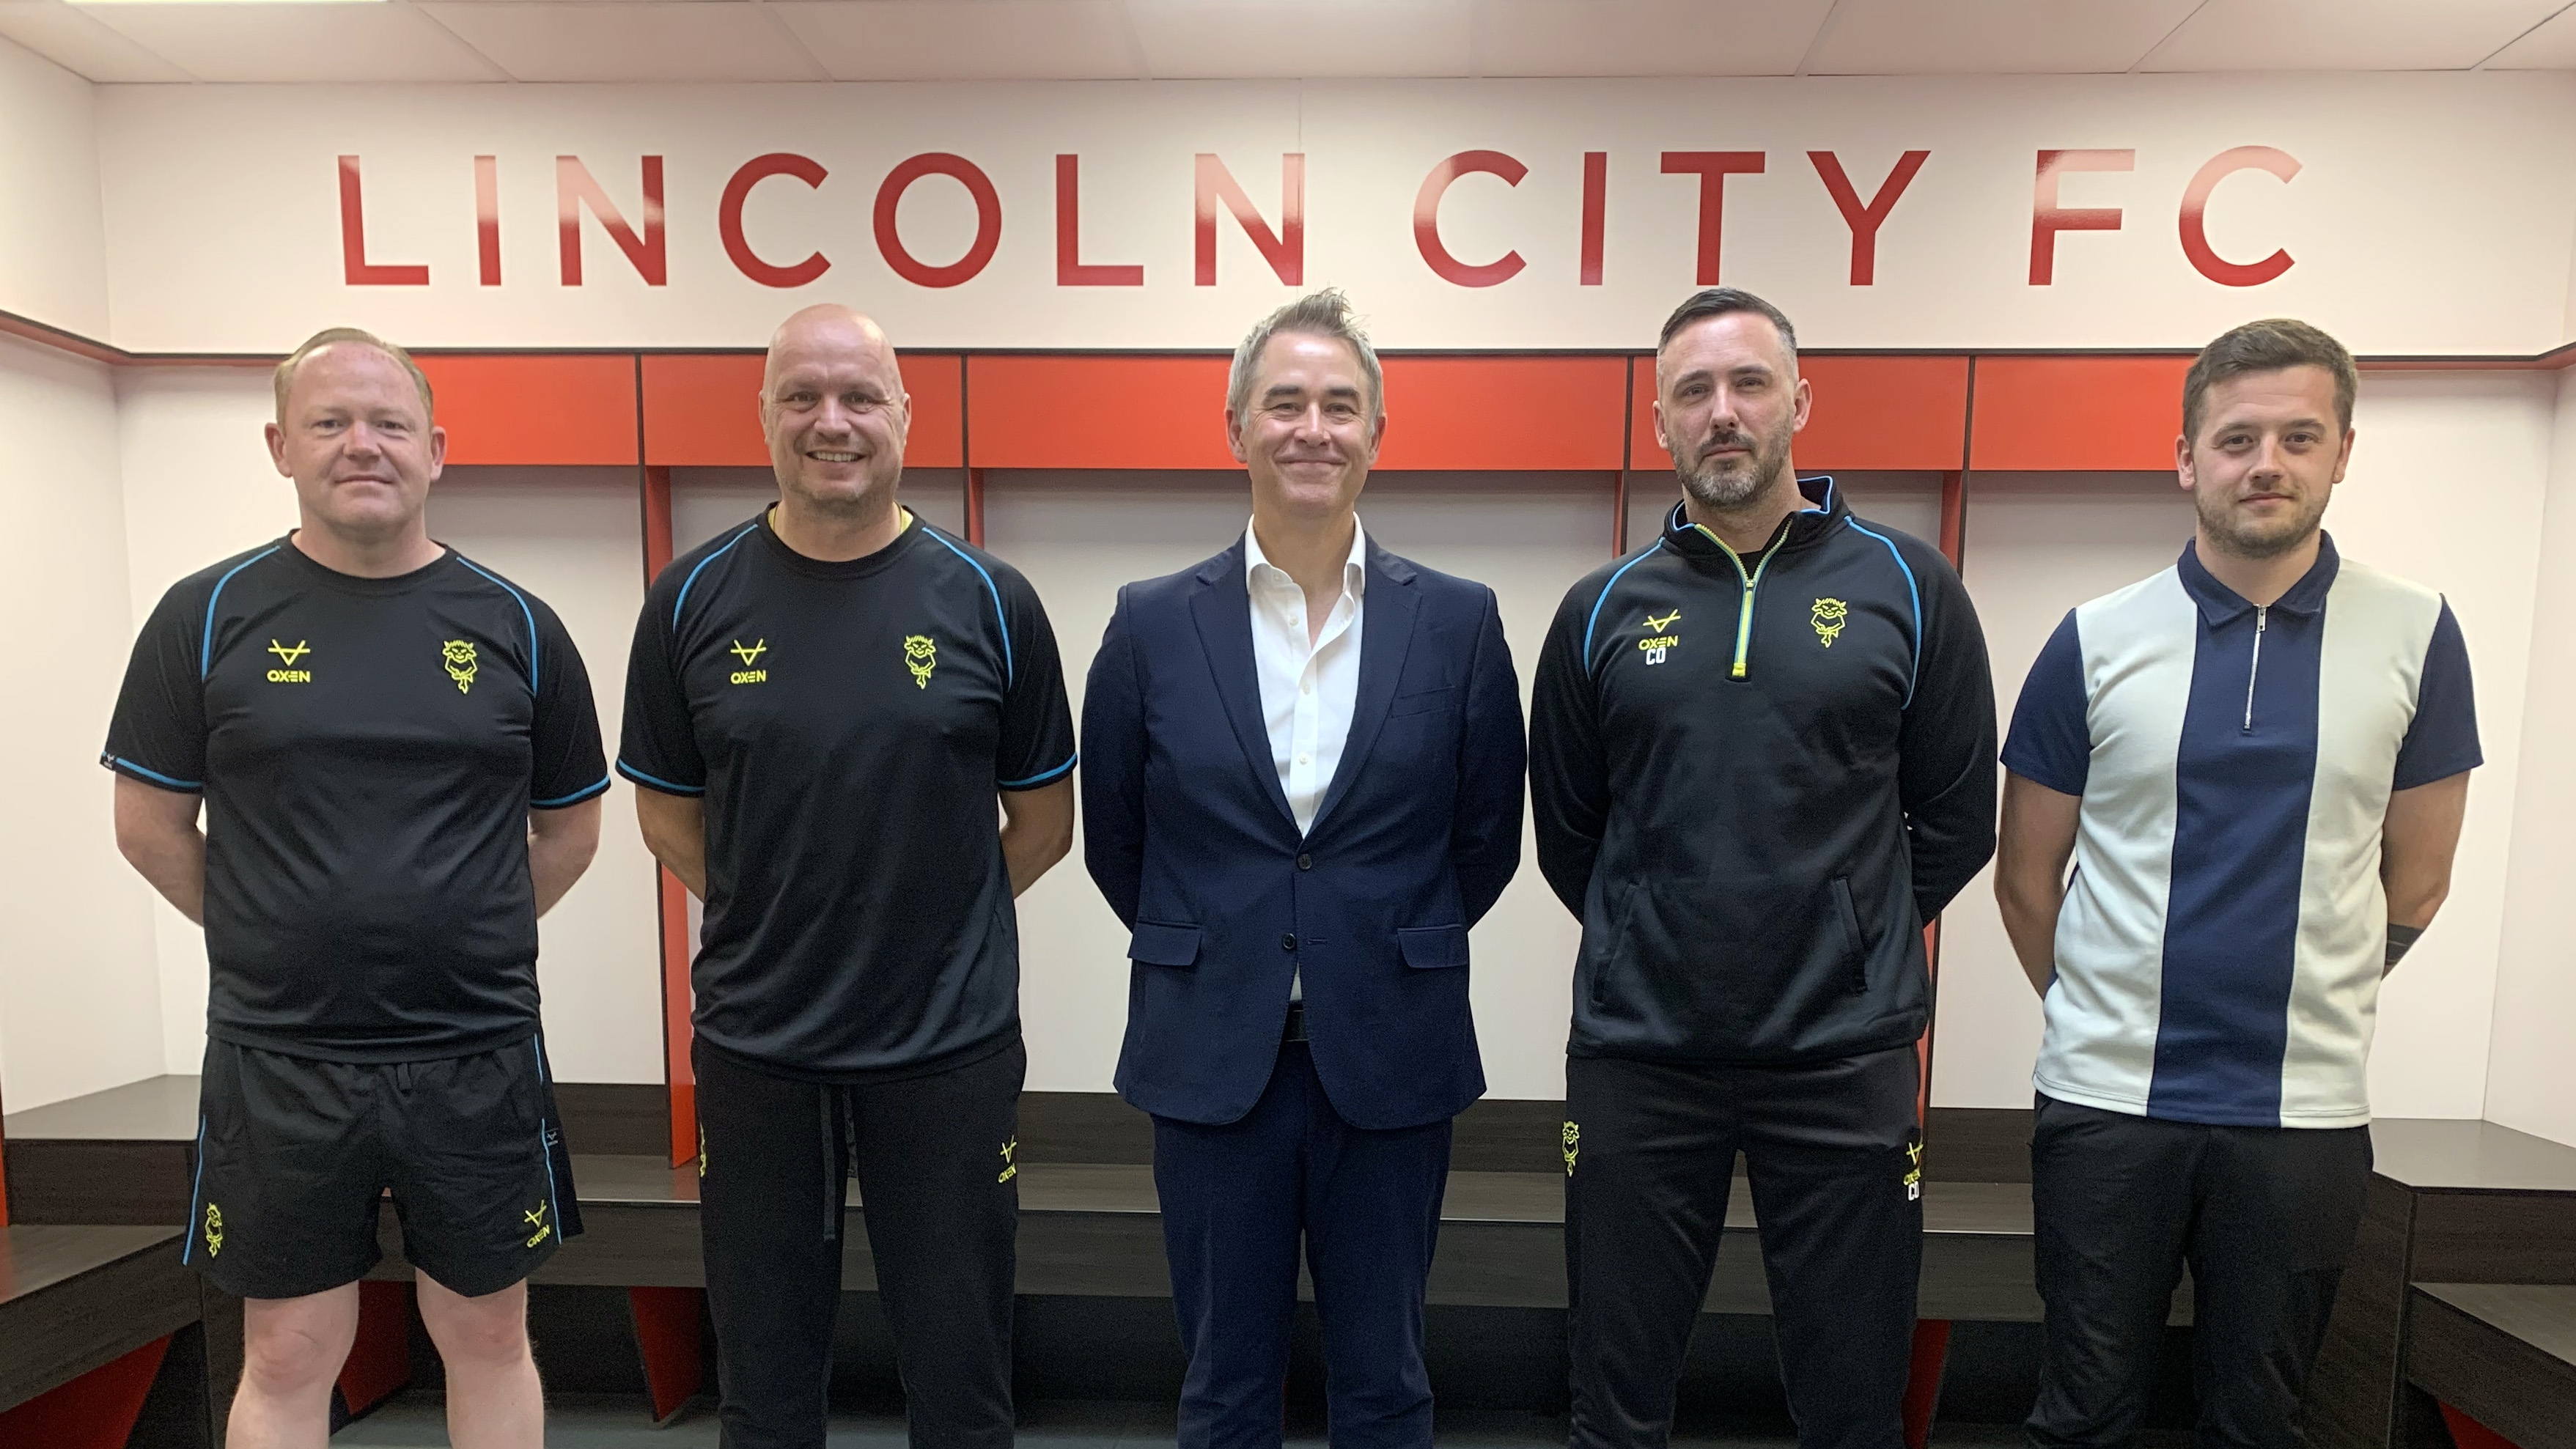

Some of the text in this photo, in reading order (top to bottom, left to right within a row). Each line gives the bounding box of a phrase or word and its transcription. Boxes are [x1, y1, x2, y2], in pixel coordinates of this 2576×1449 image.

[337, 145, 2303, 288] LINCOLN CITY FC
[1638, 635, 1679, 650] OXEN
[1646, 647, 1666, 665] CO
[267, 669, 311, 682] OXEN
[730, 670, 766, 684] OXEN
[526, 1224, 551, 1247] OXEN
